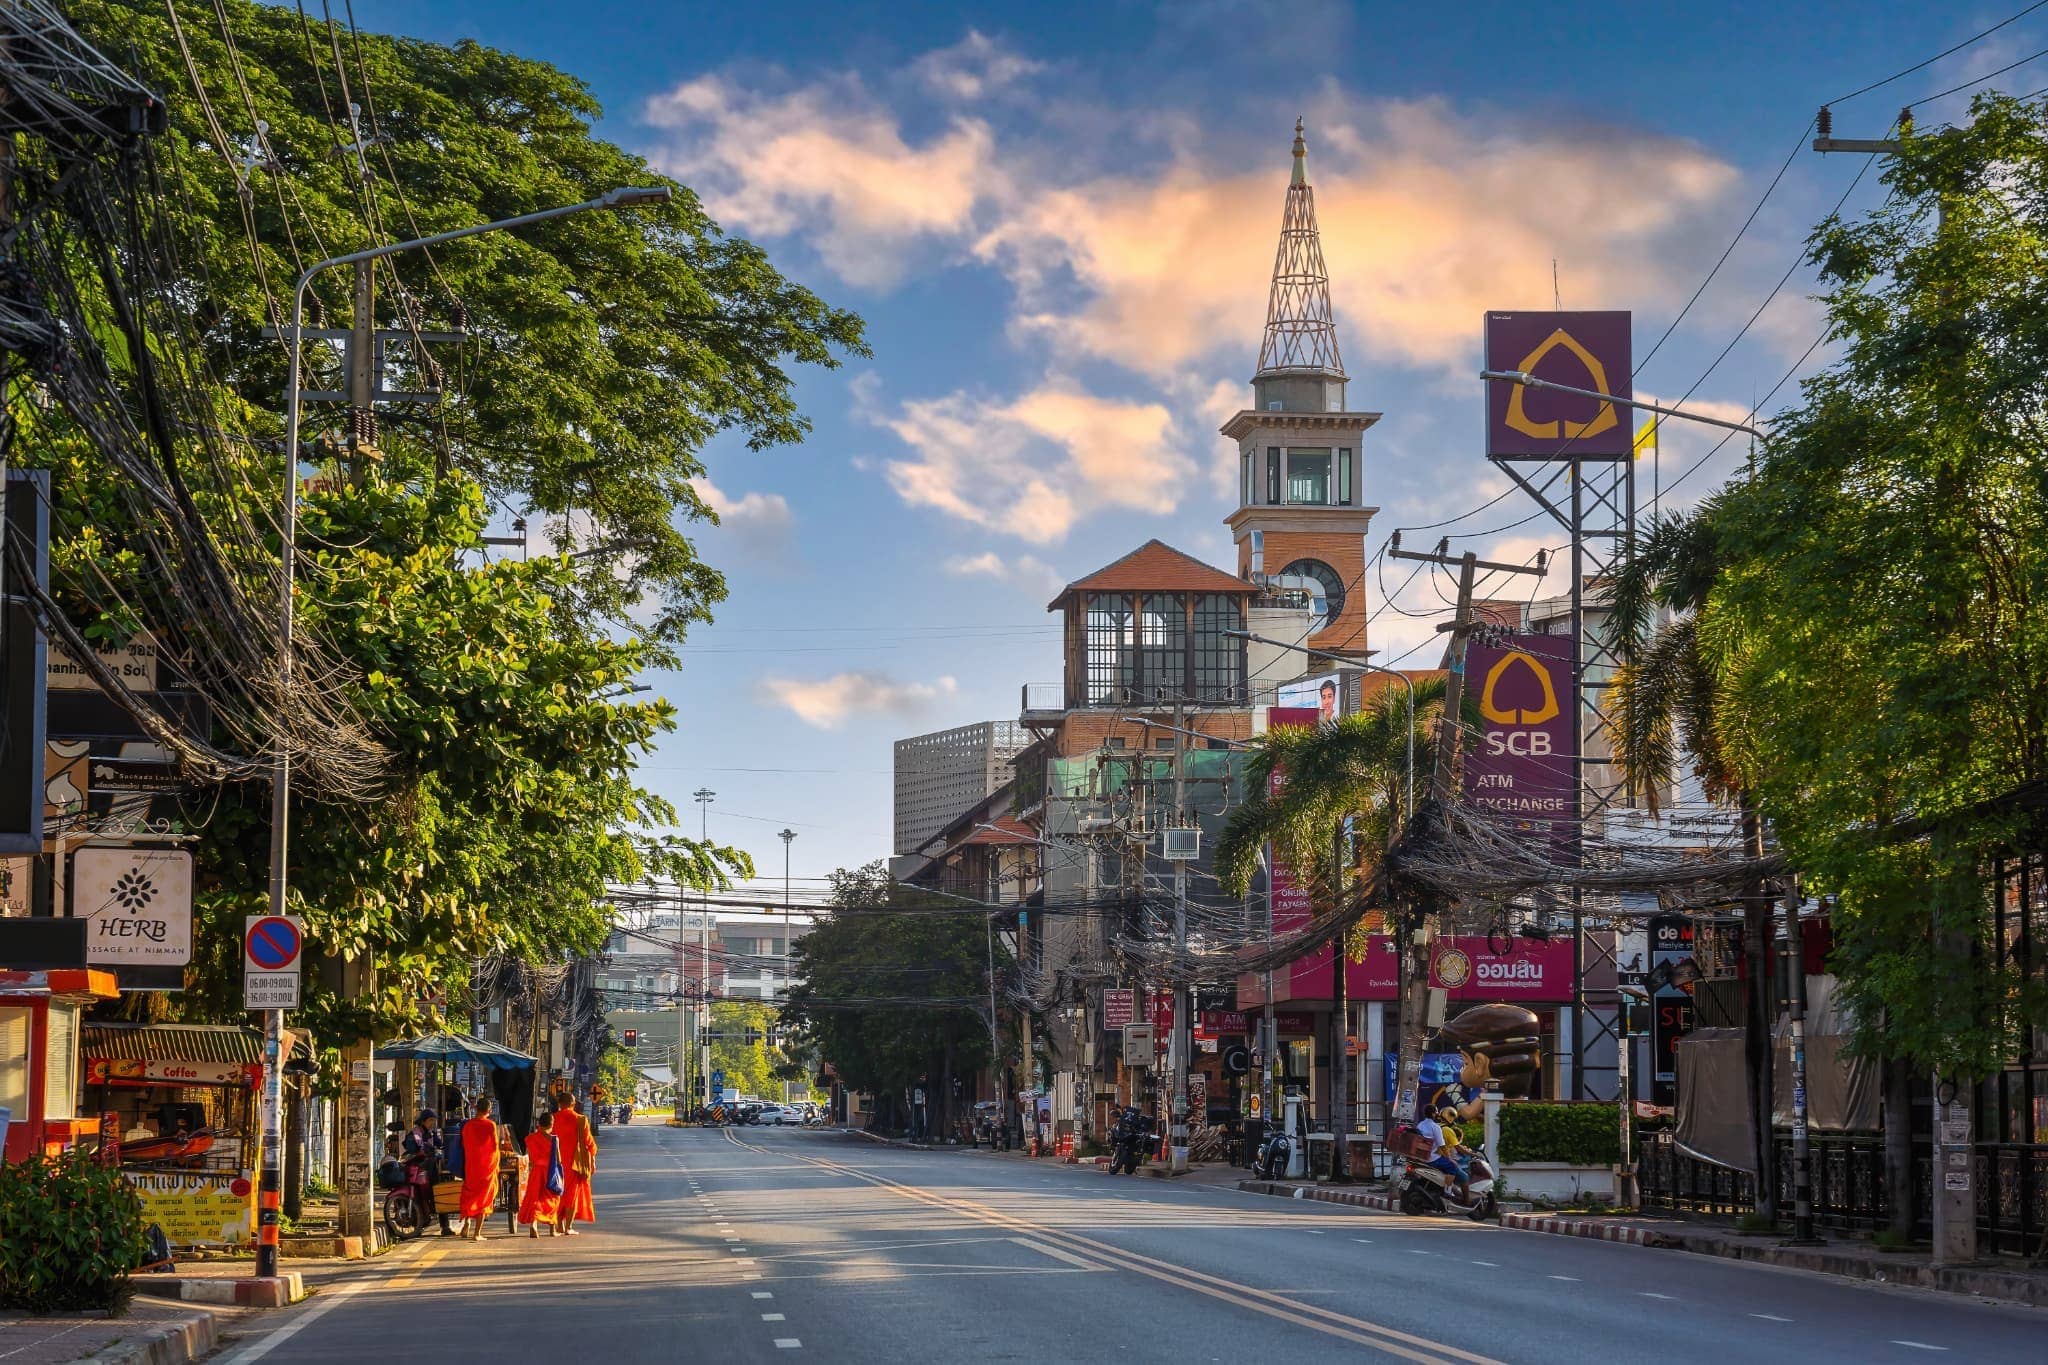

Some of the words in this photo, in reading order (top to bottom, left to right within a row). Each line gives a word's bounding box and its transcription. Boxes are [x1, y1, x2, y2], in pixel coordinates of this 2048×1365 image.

[179, 647, 195, 668] 4
[123, 664, 146, 676] Soi
[1486, 731, 1552, 756] SCB
[1476, 774, 1513, 788] ATM
[1476, 798, 1565, 811] EXCHANGE
[1281, 889, 1308, 897] ONLINE
[688, 918, 716, 928] HOEL
[100, 918, 166, 942] HERB
[1658, 925, 1678, 939] de
[1476, 960, 1543, 979] ออมสิน
[1224, 1014, 1246, 1025] ATM
[163, 1066, 198, 1078] Coffee
